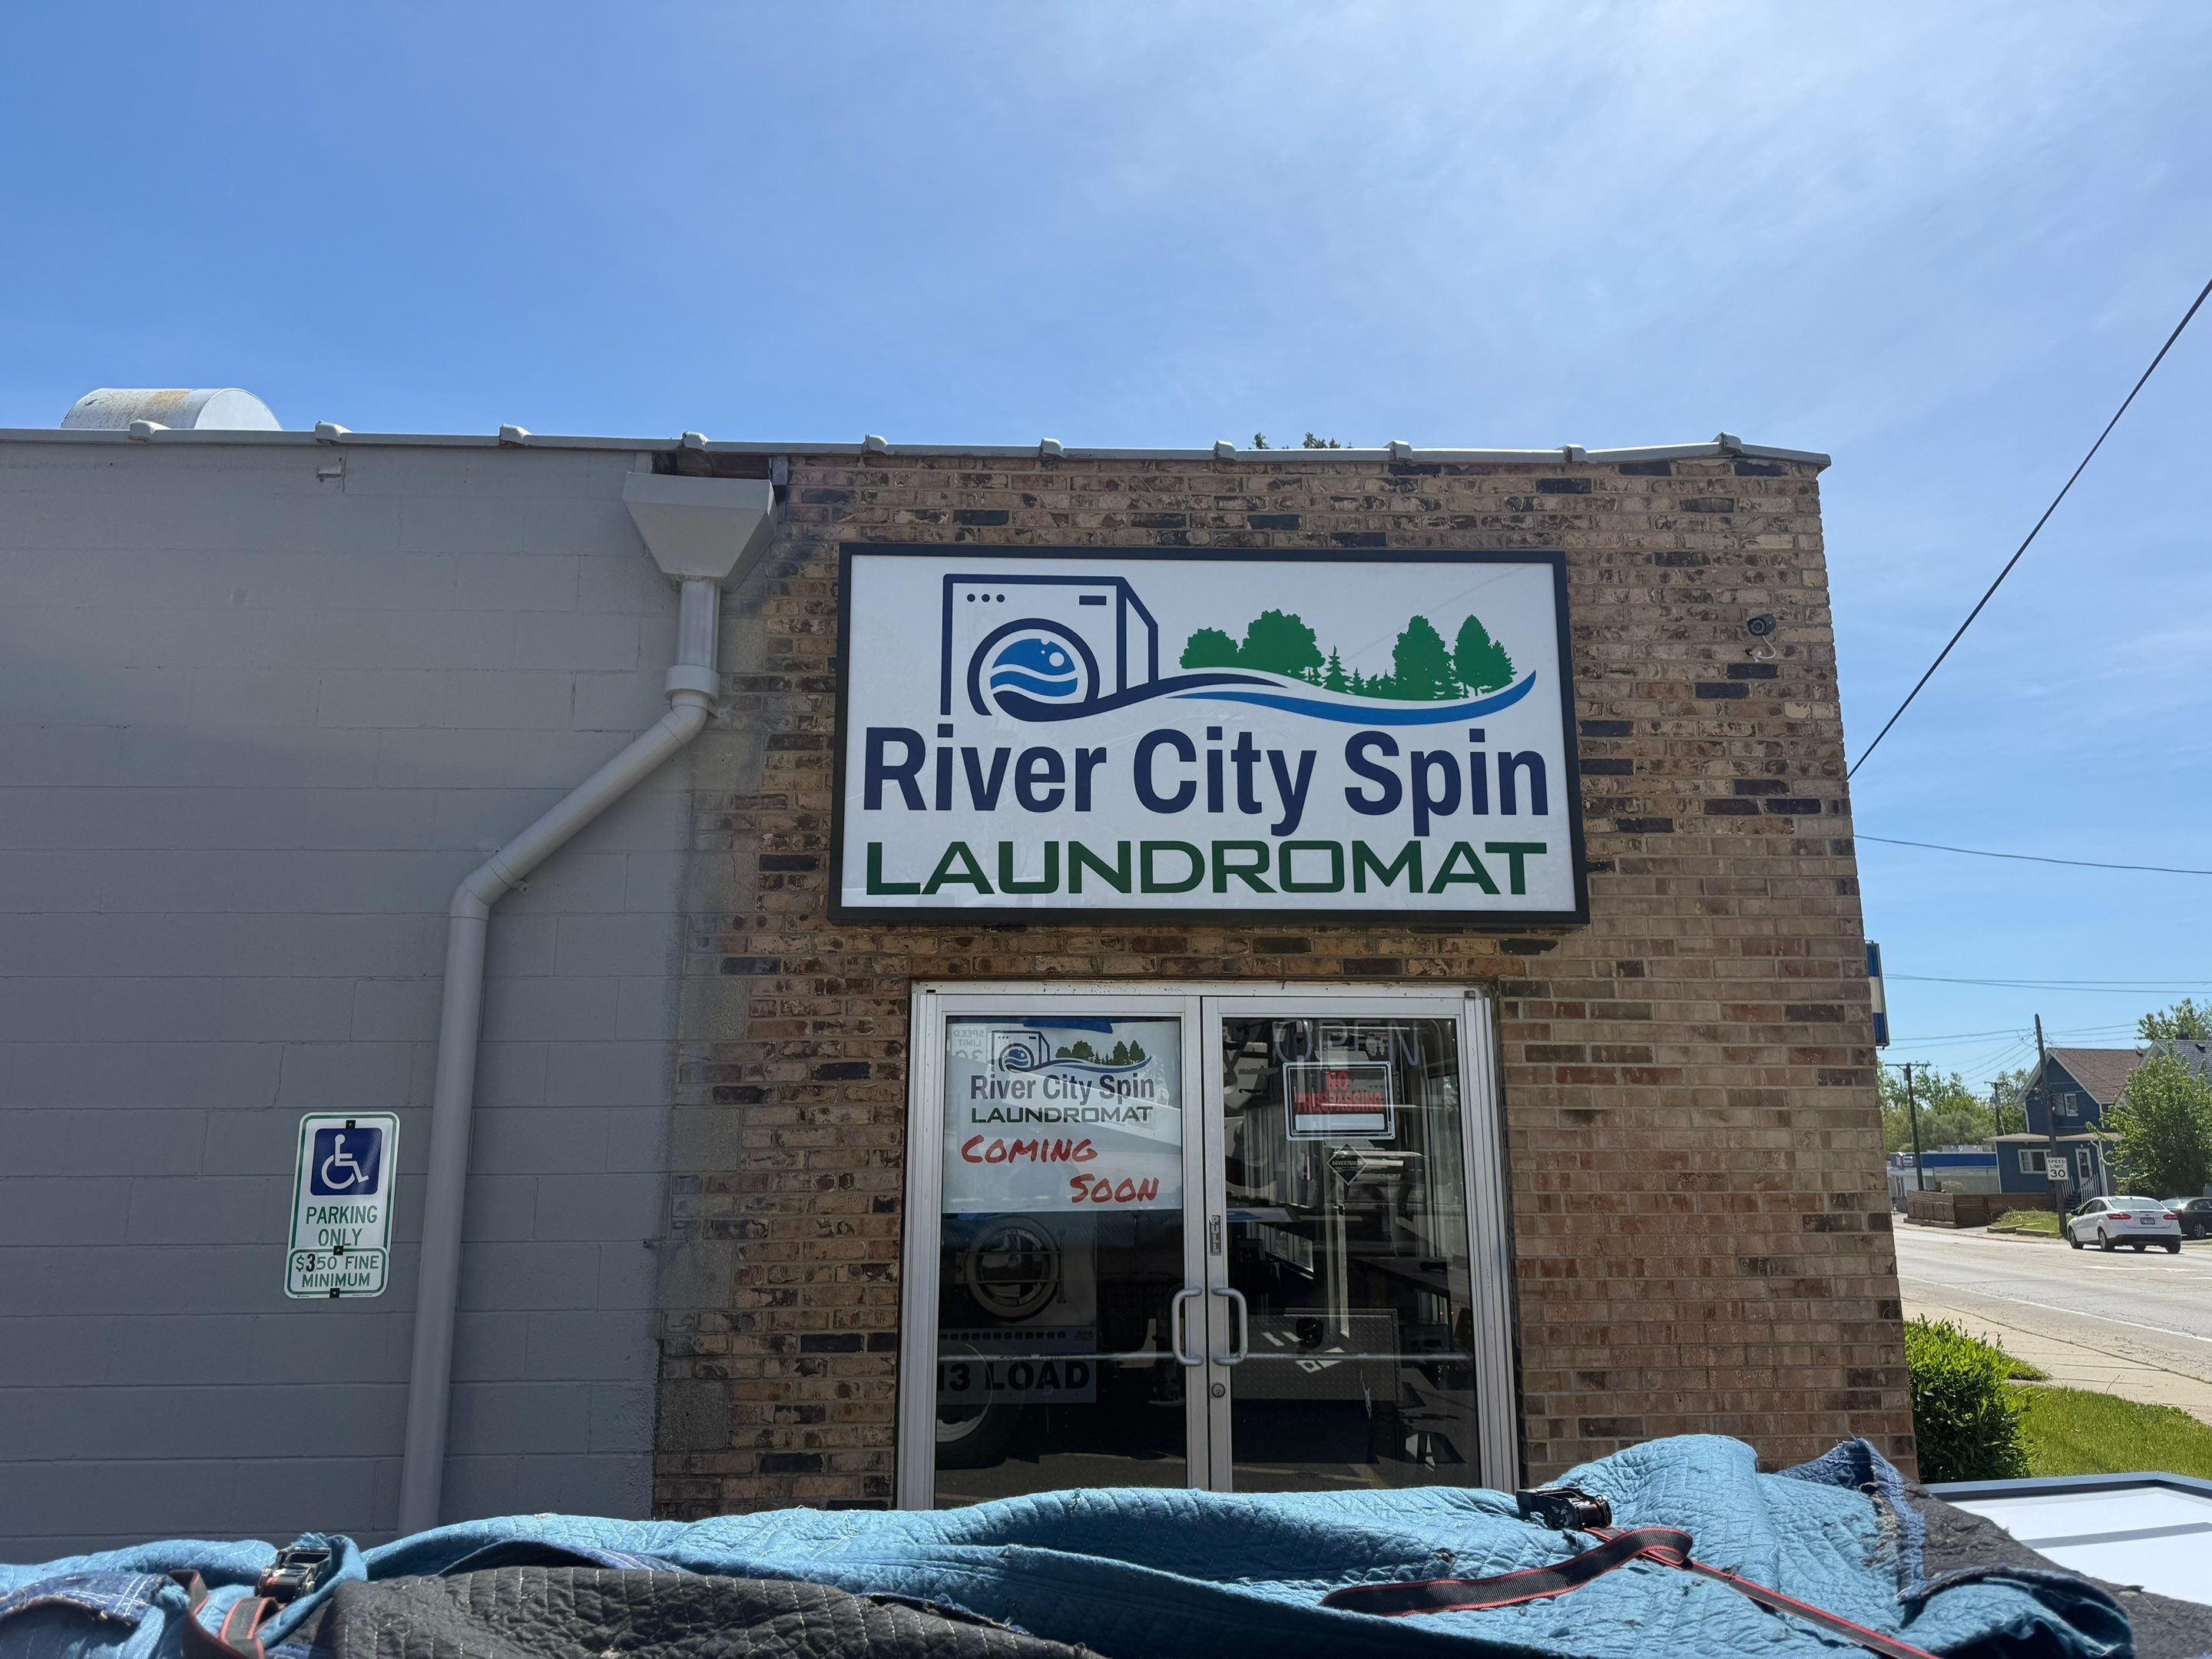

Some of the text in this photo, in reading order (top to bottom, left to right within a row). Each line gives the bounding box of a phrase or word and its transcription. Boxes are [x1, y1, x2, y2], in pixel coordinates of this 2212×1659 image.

[863, 723, 1548, 836] River City Spin
[866, 839, 1548, 896] LAUNDROMAT
[971, 1073, 1154, 1105] River City Spin
[1326, 1071, 1349, 1091] NO
[1296, 1092, 1384, 1113] TRESPASSING
[971, 1106, 1154, 1123] LAUNDROMAT
[961, 1134, 1098, 1164] COMING
[2051, 1169, 2065, 1177] 30
[1070, 1174, 1159, 1204] SOON
[306, 1205, 378, 1224] PARKING
[318, 1228, 363, 1247] ONLY
[295, 1253, 379, 1273] $350 FINE
[302, 1272, 370, 1287] MINIMUM
[985, 1360, 1090, 1391] LOAD
